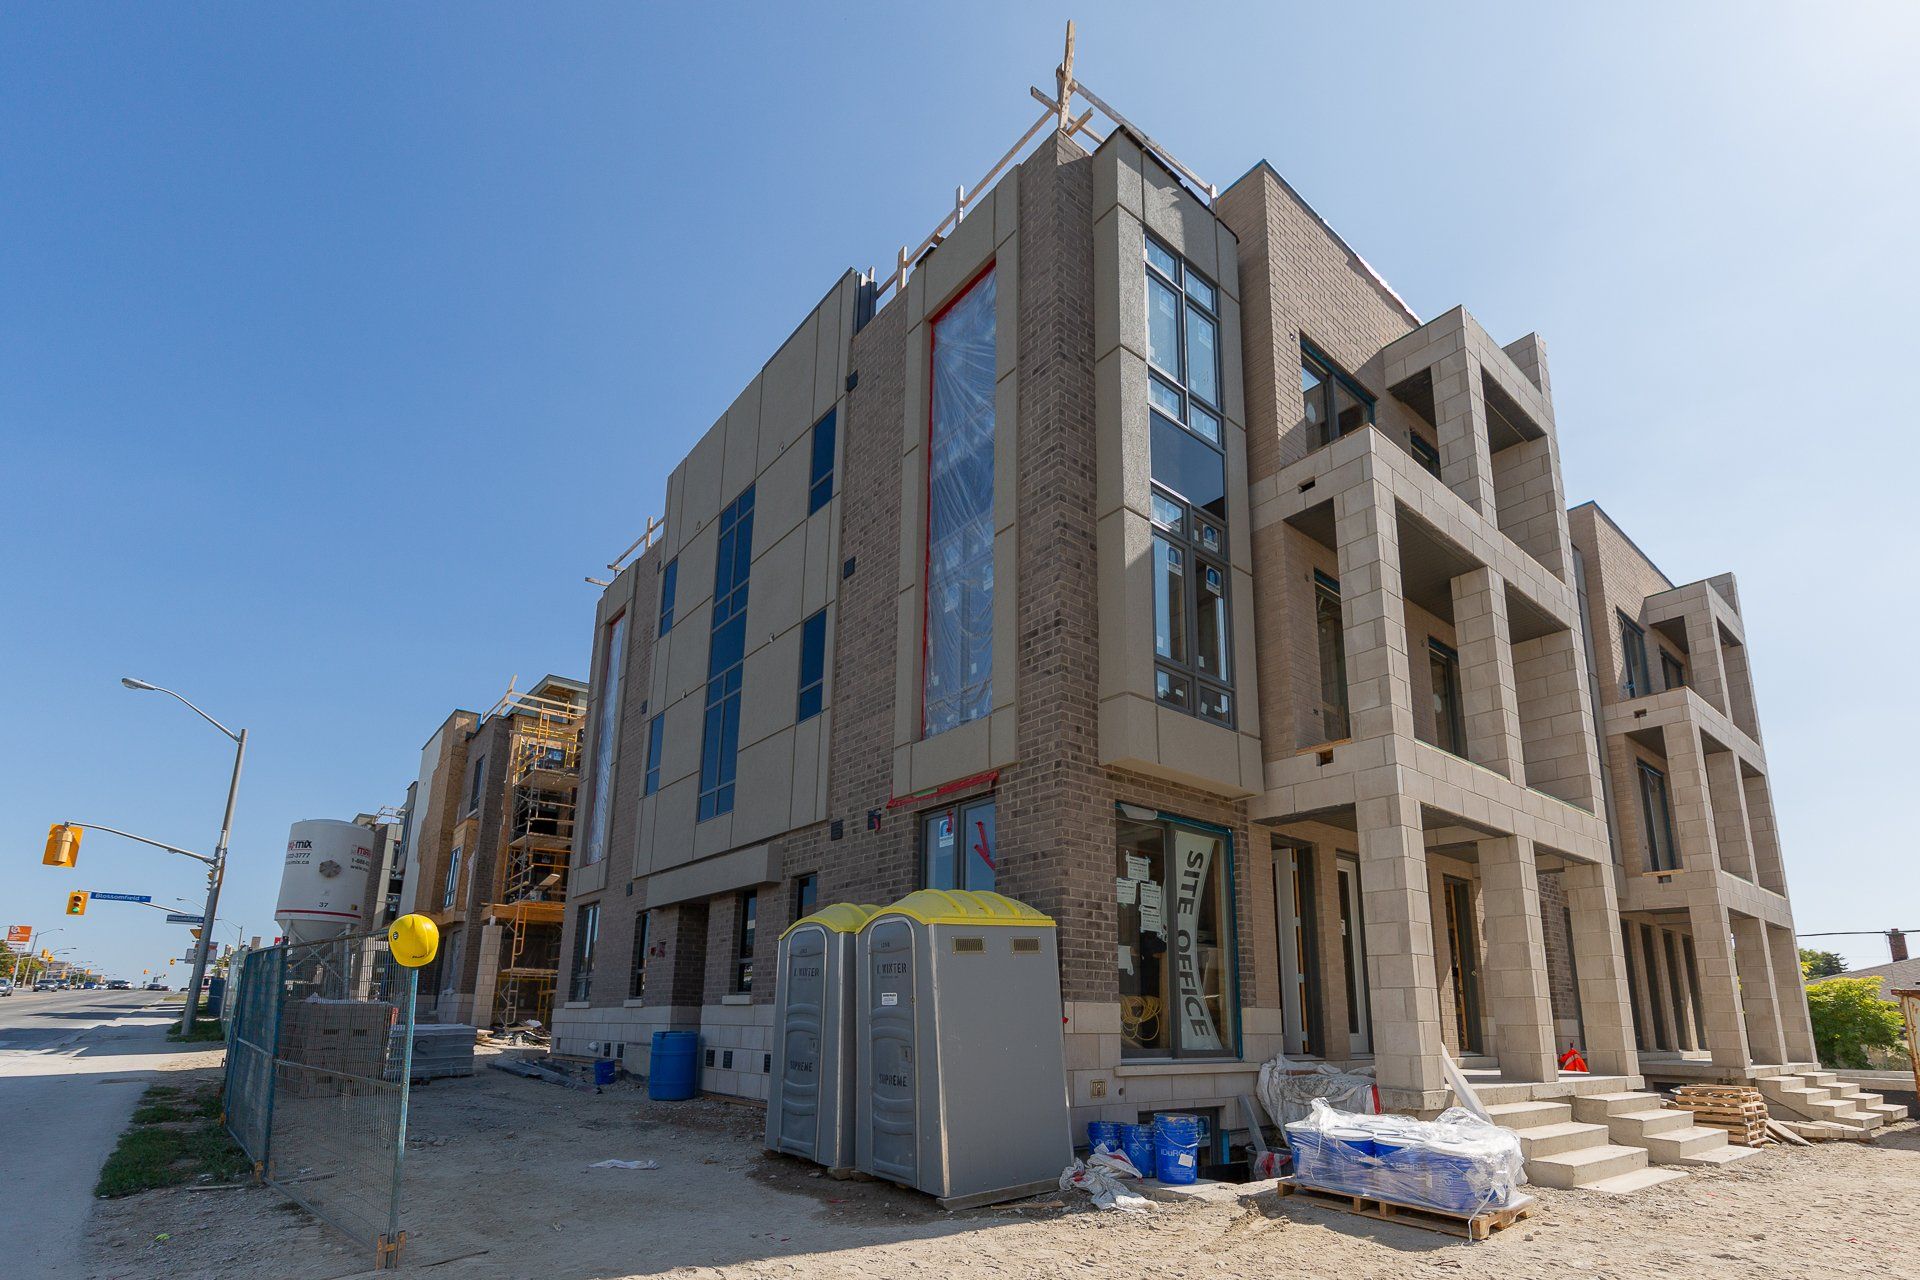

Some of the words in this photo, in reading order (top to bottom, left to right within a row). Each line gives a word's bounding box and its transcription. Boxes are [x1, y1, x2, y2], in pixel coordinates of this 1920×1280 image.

[95, 893, 140, 901] Blossomfield
[1177, 850, 1204, 916] SITE
[1177, 929, 1211, 1037] OFFICE
